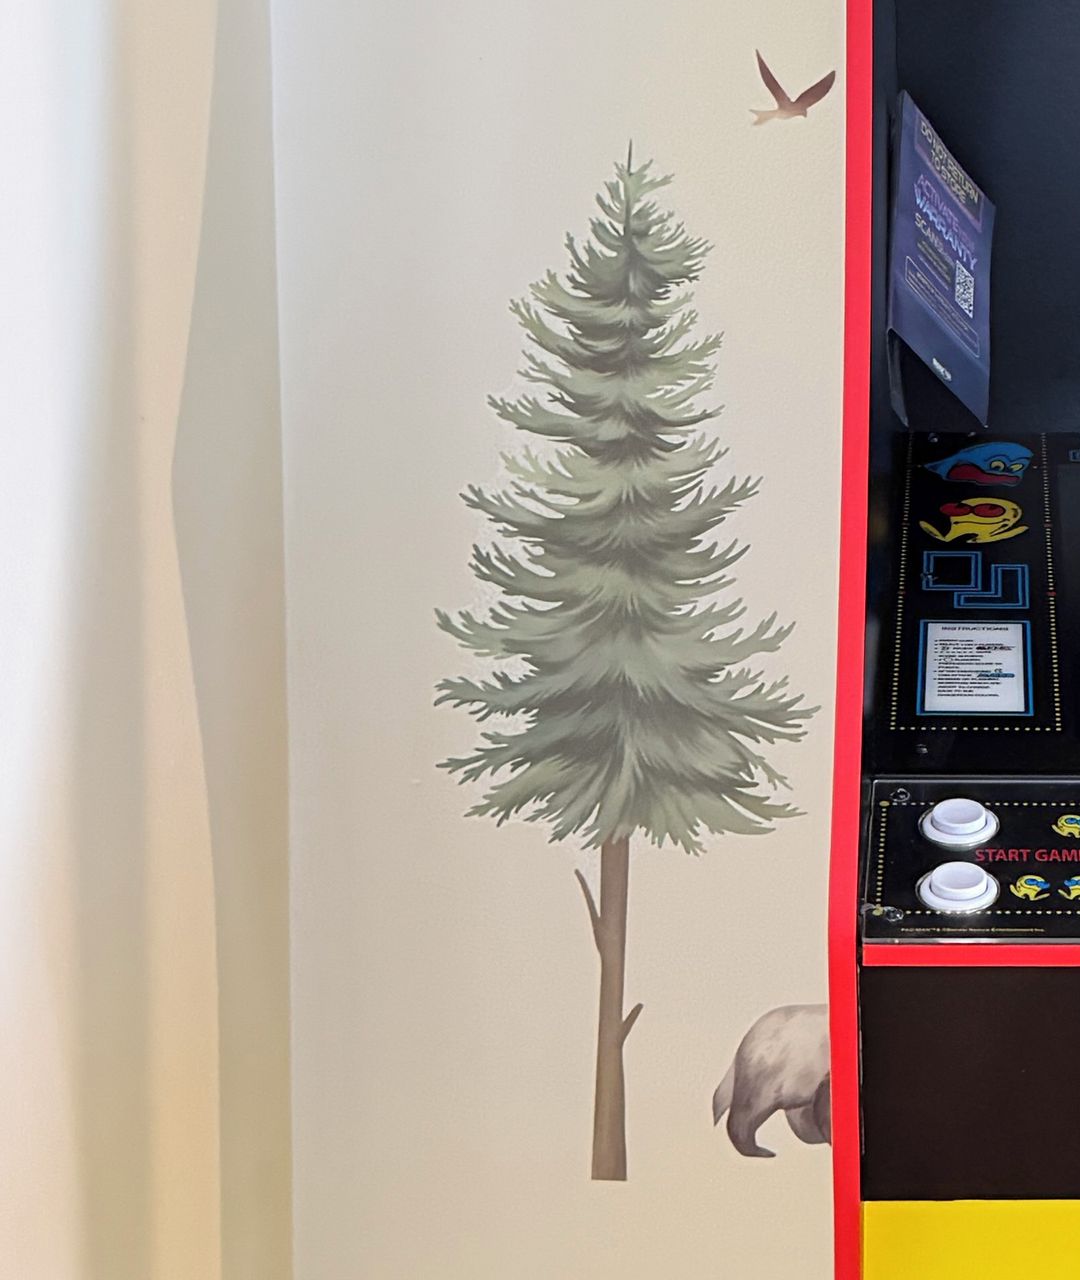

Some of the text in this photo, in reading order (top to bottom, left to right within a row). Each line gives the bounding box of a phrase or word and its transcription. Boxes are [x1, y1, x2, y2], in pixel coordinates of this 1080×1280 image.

[947, 156, 979, 205] RETURN
[913, 183, 978, 271] WARRANTY
[975, 848, 1031, 862] START
